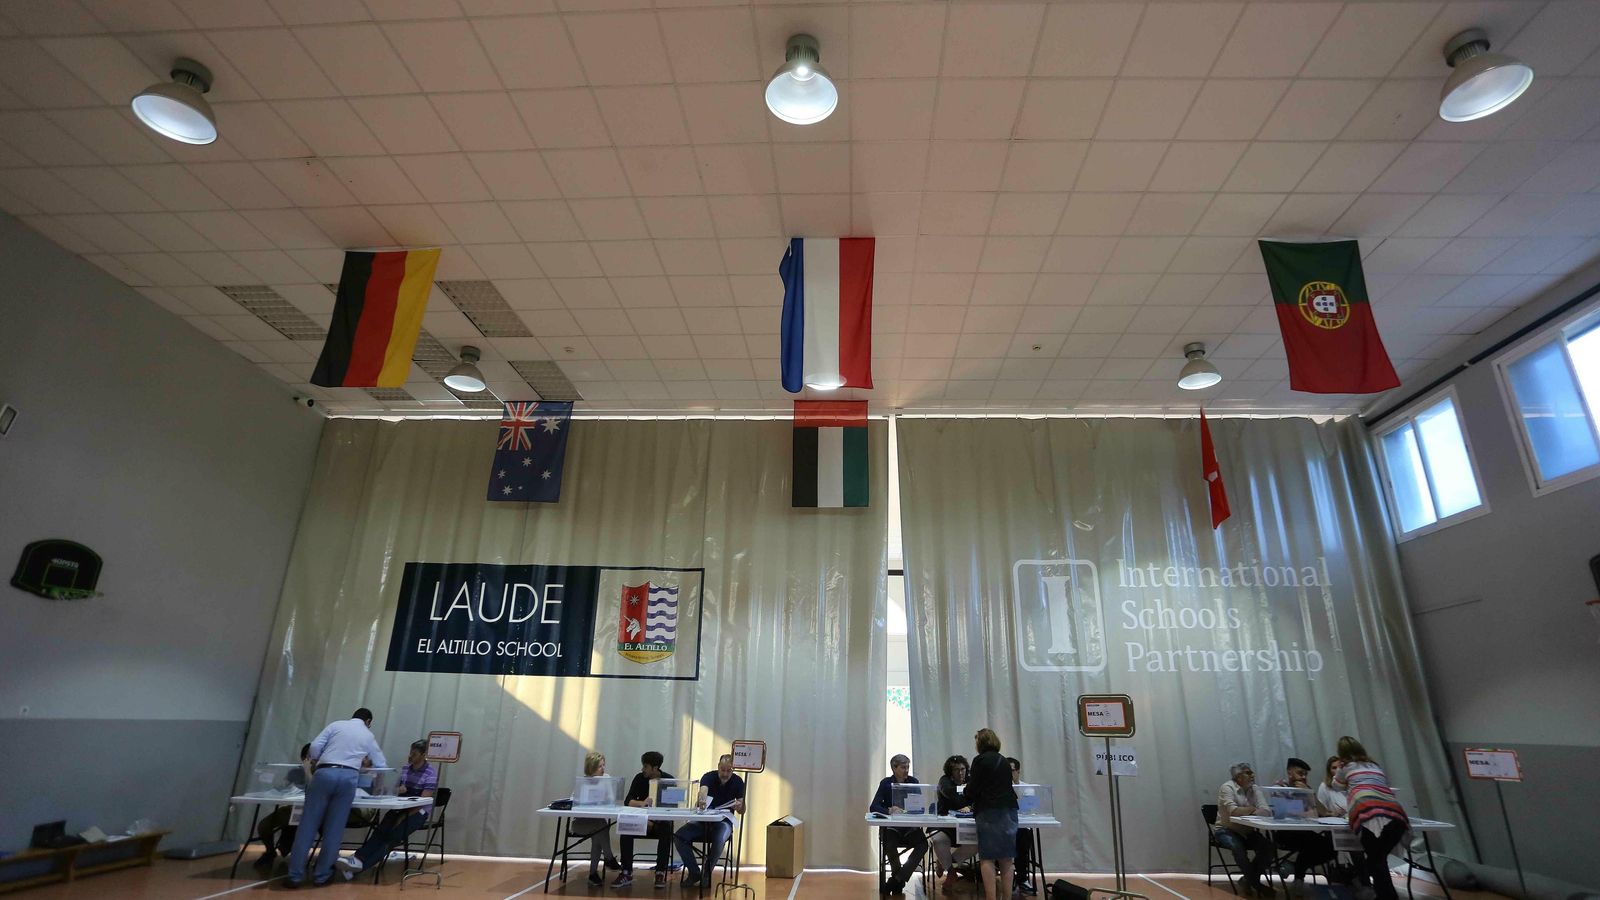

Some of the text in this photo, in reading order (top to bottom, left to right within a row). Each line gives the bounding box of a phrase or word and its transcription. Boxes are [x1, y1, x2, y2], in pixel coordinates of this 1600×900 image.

[1115, 557, 1333, 588] International
[430, 581, 564, 624] LAUDE
[1121, 598, 1241, 630] Schools
[417, 638, 563, 657] EL ALTILLO SCHOOL
[624, 642, 668, 652] EL ALTILLO
[1125, 640, 1324, 680] Partnership
